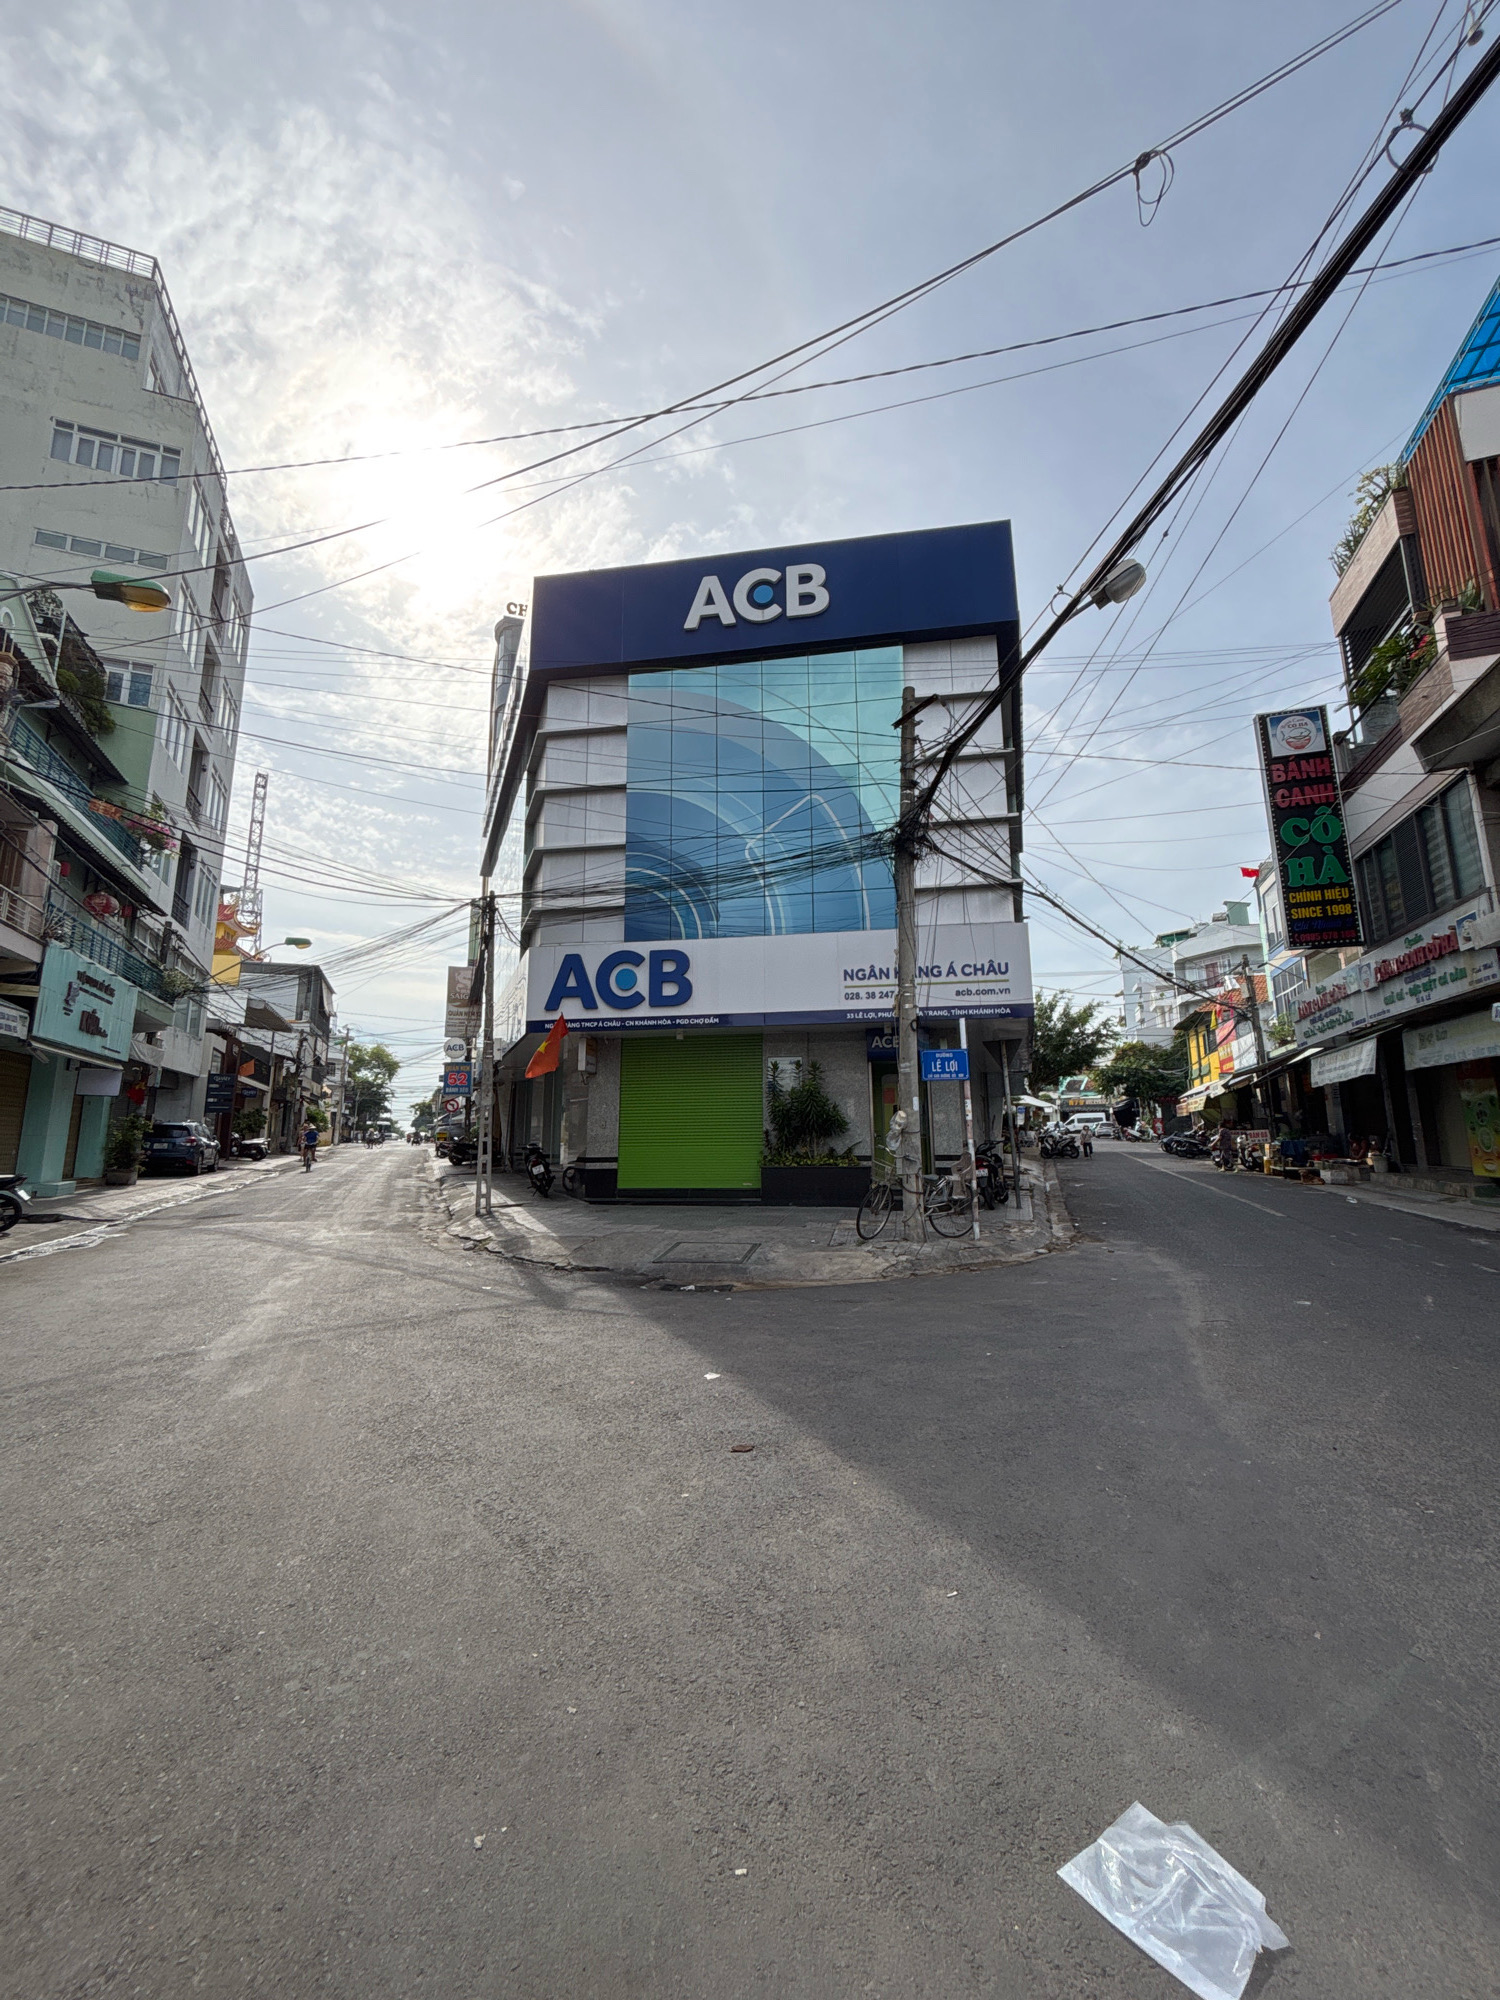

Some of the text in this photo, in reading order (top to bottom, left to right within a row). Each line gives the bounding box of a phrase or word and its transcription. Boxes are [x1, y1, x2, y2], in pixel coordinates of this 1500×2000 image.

[683, 563, 830, 632] ACB
[1270, 756, 1332, 784] BÁNH
[1274, 782, 1335, 808] CANH
[1280, 805, 1342, 847] CÔ
[1285, 845, 1350, 887] HÀ
[1289, 886, 1350, 904] CHÍNH HIỆU
[1290, 903, 1352, 919] SINCE 1998
[843, 964, 890, 981] NGÂN
[946, 961, 957, 977] Á
[960, 959, 1009, 976] CHÂU
[544, 949, 693, 1011] ACB
[865, 991, 876, 1000] 38
[878, 990, 895, 999] 247
[955, 987, 1011, 997] acb.com.vn
[969, 1007, 994, 1015] KHÁNH
[446, 1043, 465, 1052] ACB
[931, 1058, 958, 1072] LÊ LỢI
[447, 1072, 468, 1086] 52
